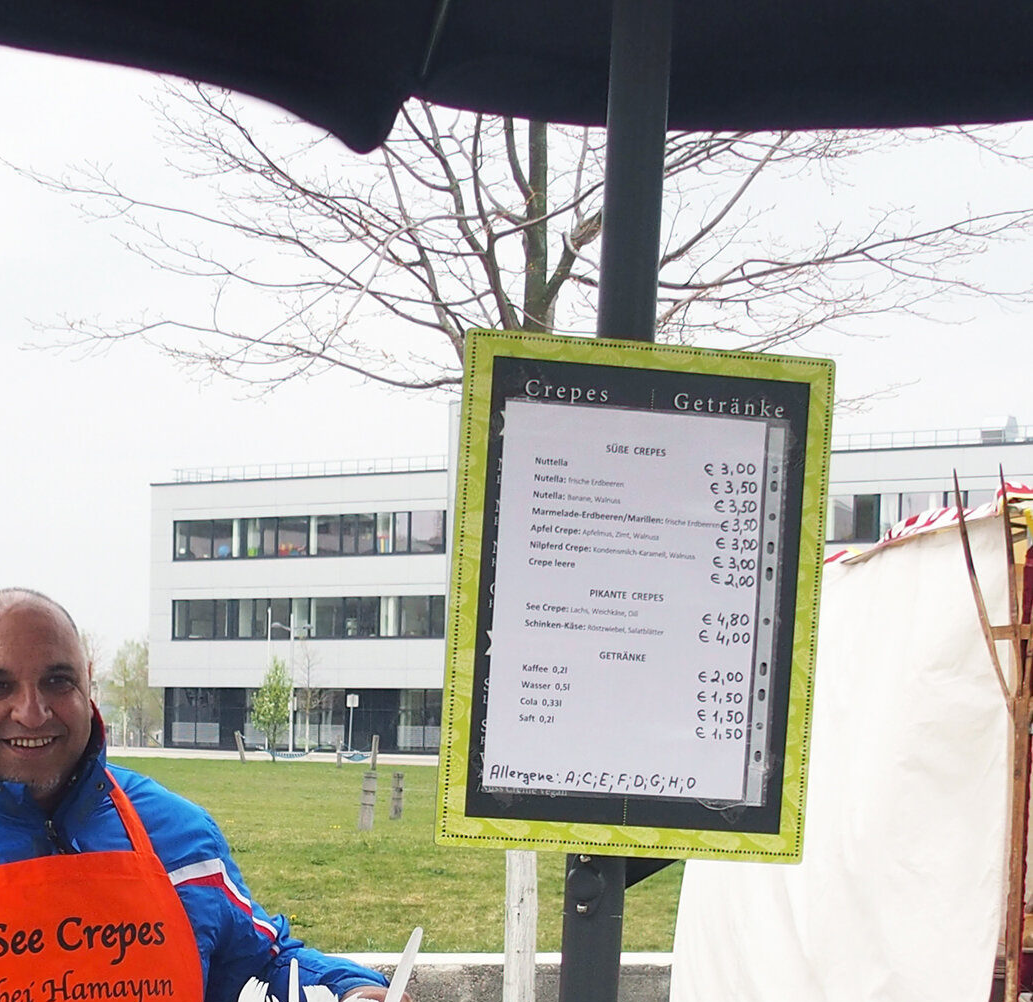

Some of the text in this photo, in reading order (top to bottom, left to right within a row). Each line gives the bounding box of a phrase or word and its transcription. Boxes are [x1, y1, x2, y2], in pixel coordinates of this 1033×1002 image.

[524, 379, 609, 404] Crepes
[674, 393, 785, 418] Getränke
[633, 446, 666, 457] CREPES
[535, 457, 568, 467] Nuttella
[704, 463, 756, 476] € 3,00
[534, 474, 566, 484] Nutella:
[591, 478, 624, 488] Erdbeeren
[710, 480, 758, 495] € 3,50
[533, 491, 565, 501] Nutella:
[714, 499, 757, 516] € 3,50
[532, 507, 664, 525] Marmelade-Erdbeeren/Marillen:
[531, 524, 553, 534] Apfel
[554, 525, 581, 535] Crepe:
[720, 518, 757, 535] € 3,50
[530, 541, 563, 552] Nilpferd
[565, 543, 591, 553] Crepe:
[716, 537, 758, 554] € 3,00
[528, 557, 576, 569] Crepe leere
[713, 556, 756, 571] € 3,00
[711, 573, 755, 588] € 2,00
[590, 589, 664, 602] PIKANTE CREPES
[526, 602, 541, 611] See
[542, 603, 569, 613] Crepe:
[525, 619, 586, 631] Schinken-Käse:
[702, 613, 750, 630] € 4,80
[699, 630, 750, 646] € 4,00
[599, 650, 646, 662] GETRÄNKE
[522, 664, 568, 674] Kaffee 0,2l
[698, 670, 744, 686] € 2,00
[521, 681, 570, 691] Wasser 0,5l
[520, 697, 562, 707] Cola 0,33l
[697, 691, 743, 704] € 1,50
[519, 714, 555, 724] Saft 0,2l
[697, 709, 744, 724] € 1,50
[695, 726, 743, 740] € 1,50
[489, 764, 562, 784] Allergene:
[56, 917, 165, 965] Crepes
